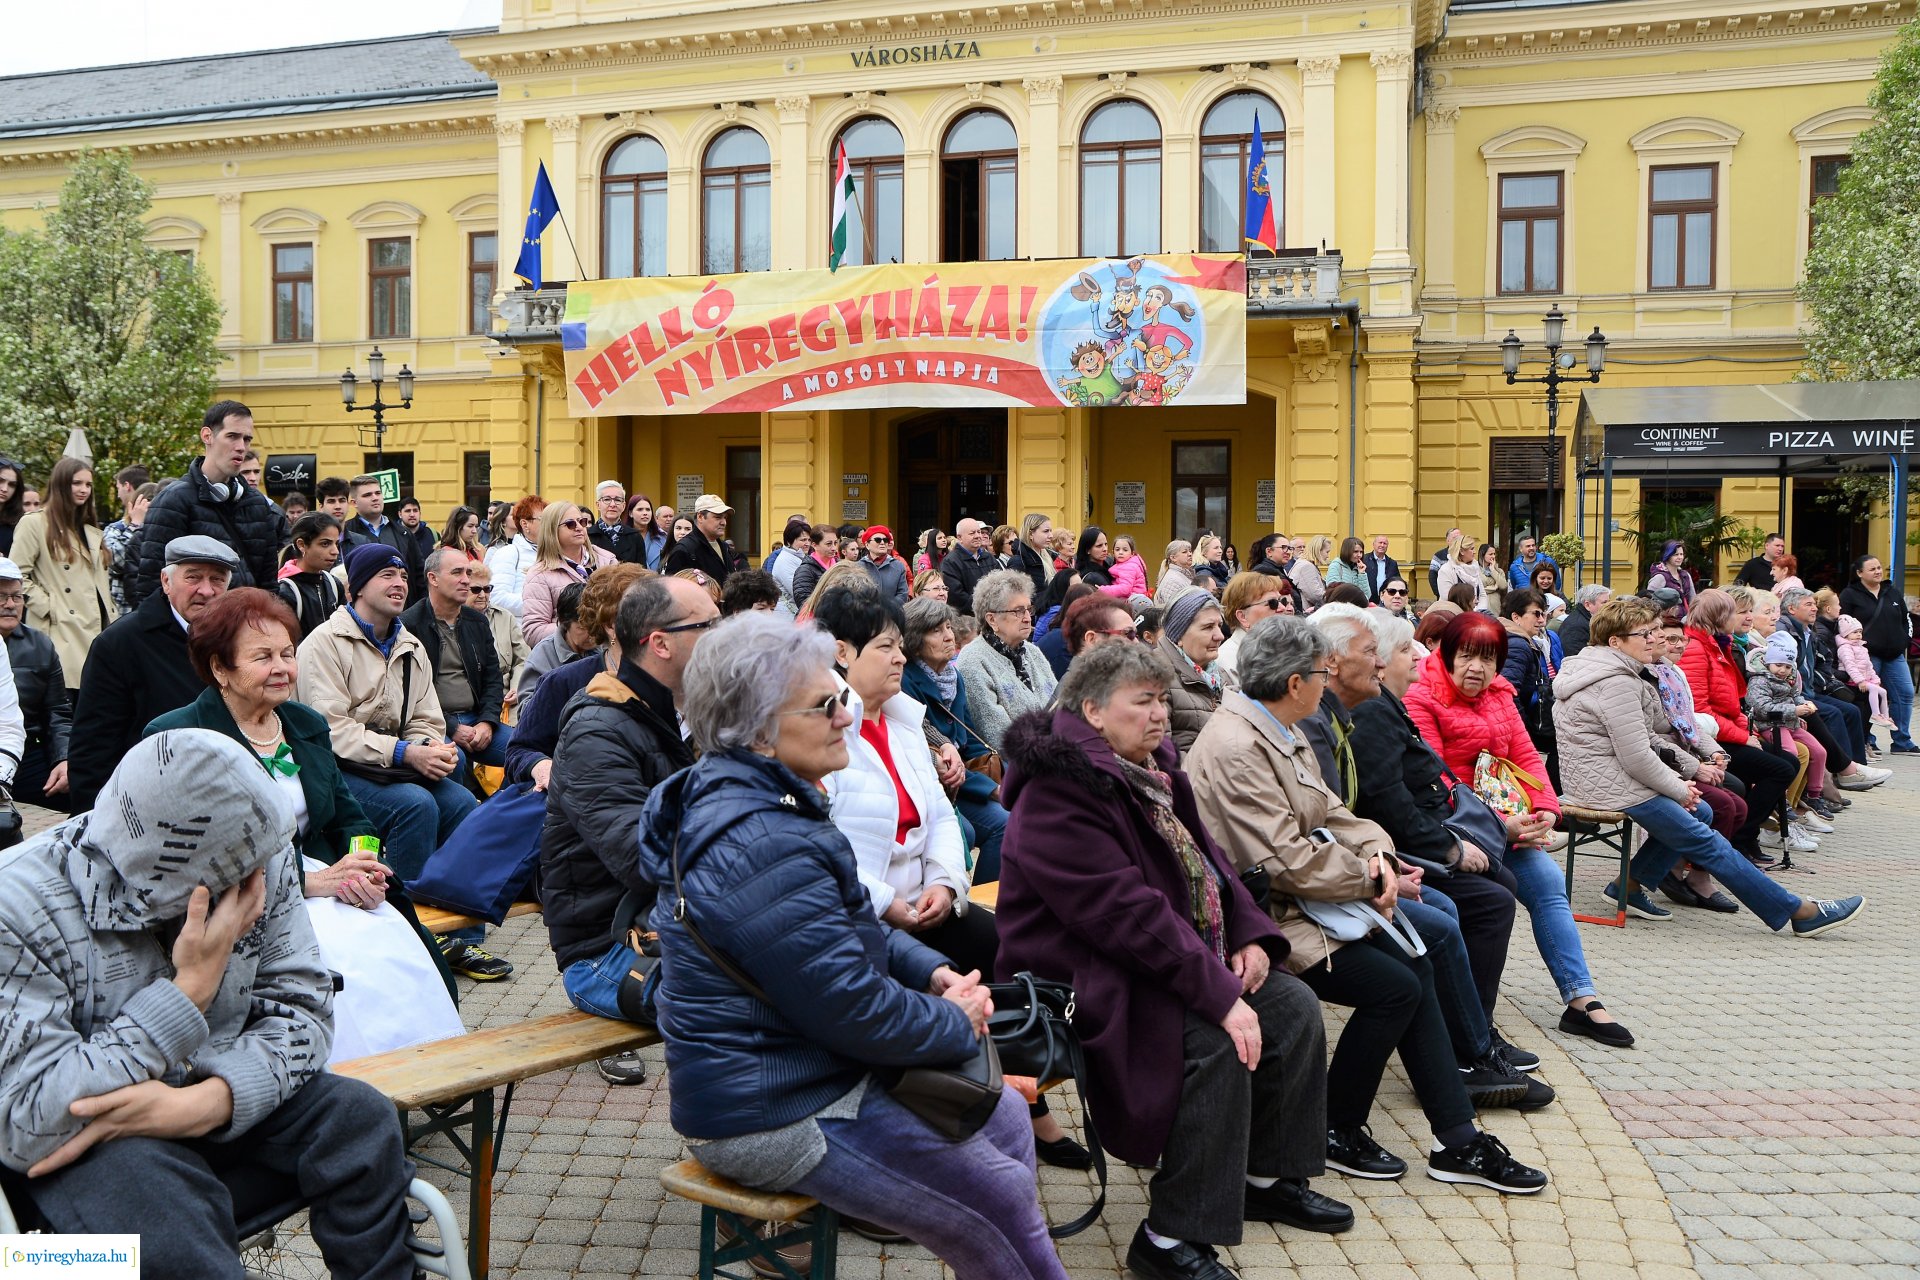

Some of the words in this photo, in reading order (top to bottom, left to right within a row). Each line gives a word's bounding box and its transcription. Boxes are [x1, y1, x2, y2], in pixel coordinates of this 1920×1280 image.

[851, 40, 981, 67] VÁROSHÁZA
[573, 279, 735, 410] HELLÓ
[653, 272, 1039, 408] NYÍREGYHÁZA!
[781, 382, 795, 401] A
[803, 359, 906, 394] MOSOLY
[915, 359, 999, 385] NAPJA
[1640, 427, 1720, 441] CONTINENT
[1769, 431, 1835, 448] PIZZA
[1852, 429, 1915, 447] WINE
